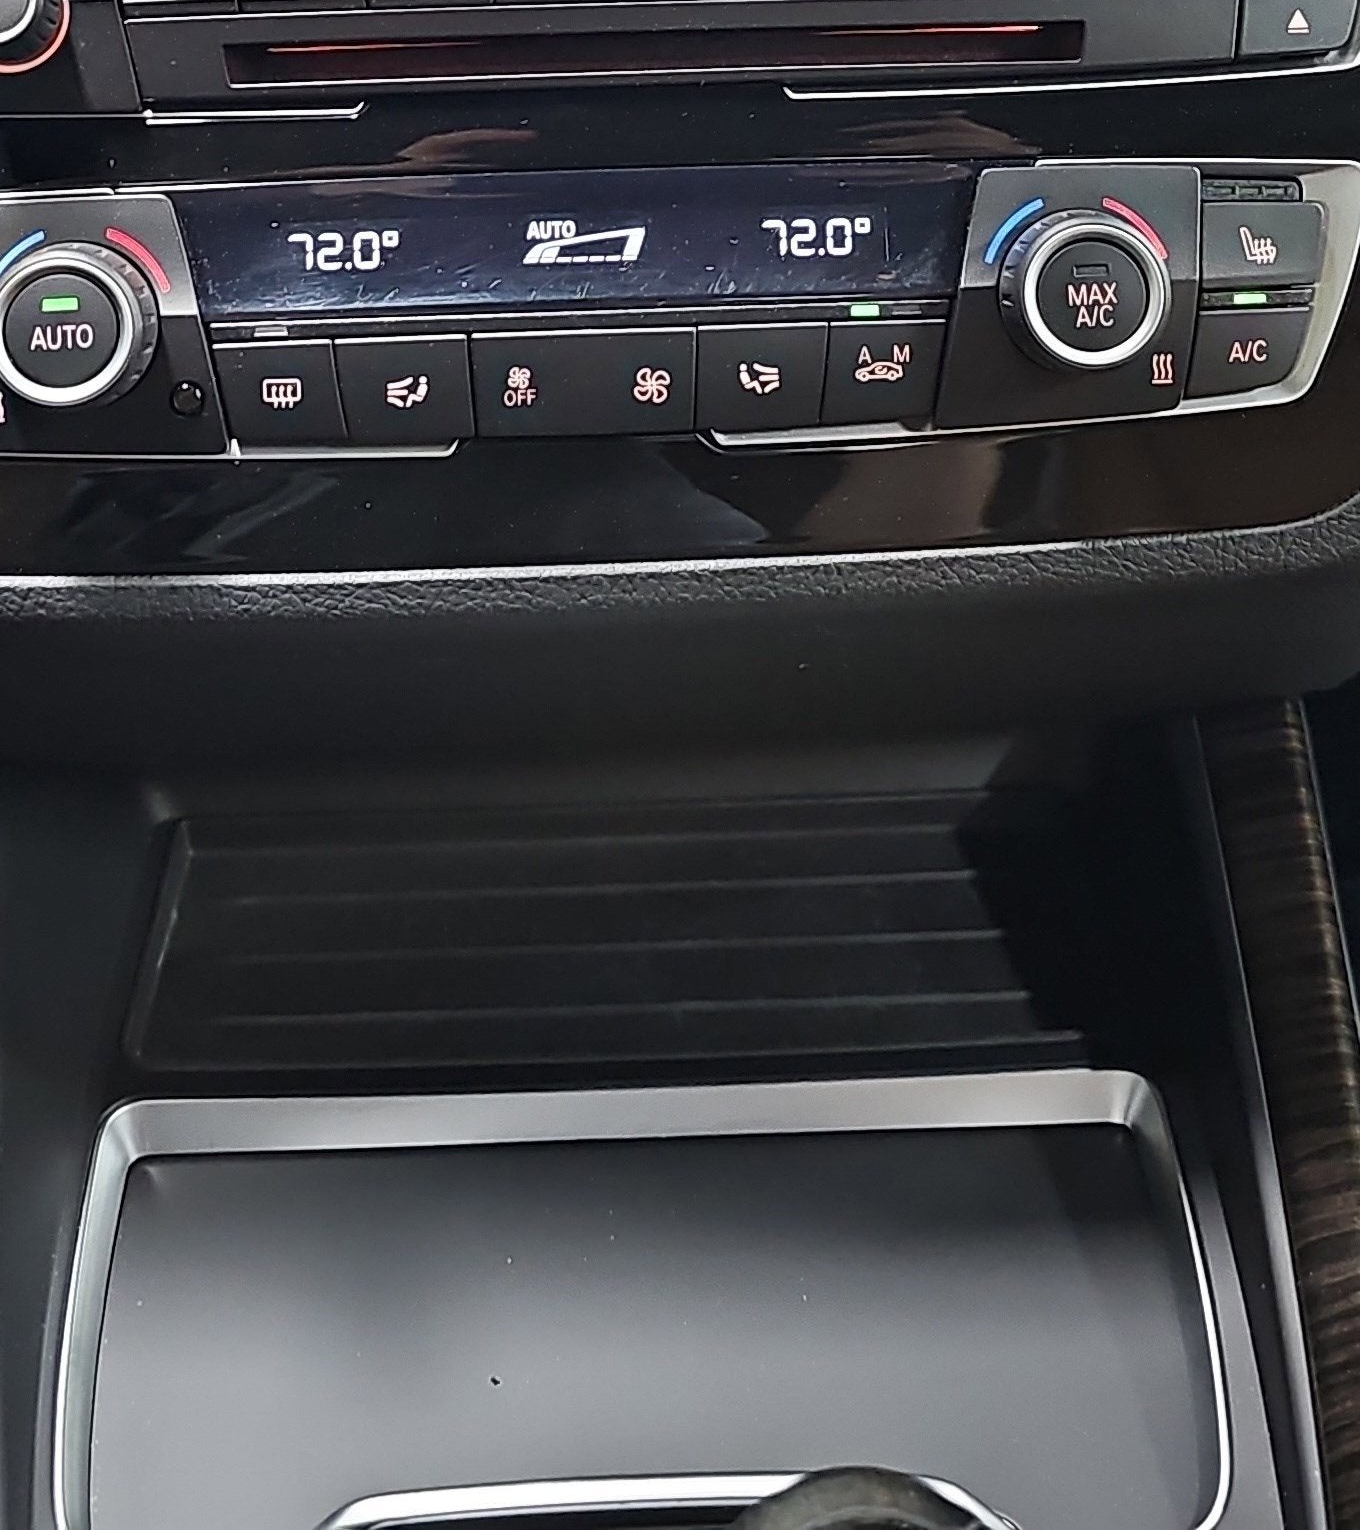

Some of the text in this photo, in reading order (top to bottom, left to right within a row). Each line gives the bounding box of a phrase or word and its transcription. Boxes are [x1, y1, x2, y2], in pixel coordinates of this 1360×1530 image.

[526, 219, 577, 241] AUTO
[1067, 282, 1118, 307] MAX
[1075, 304, 1115, 328] A/C
[30, 323, 94, 351] AUTO
[857, 344, 911, 364] A M
[1228, 339, 1267, 363] A/C
[503, 387, 537, 408] OFF
